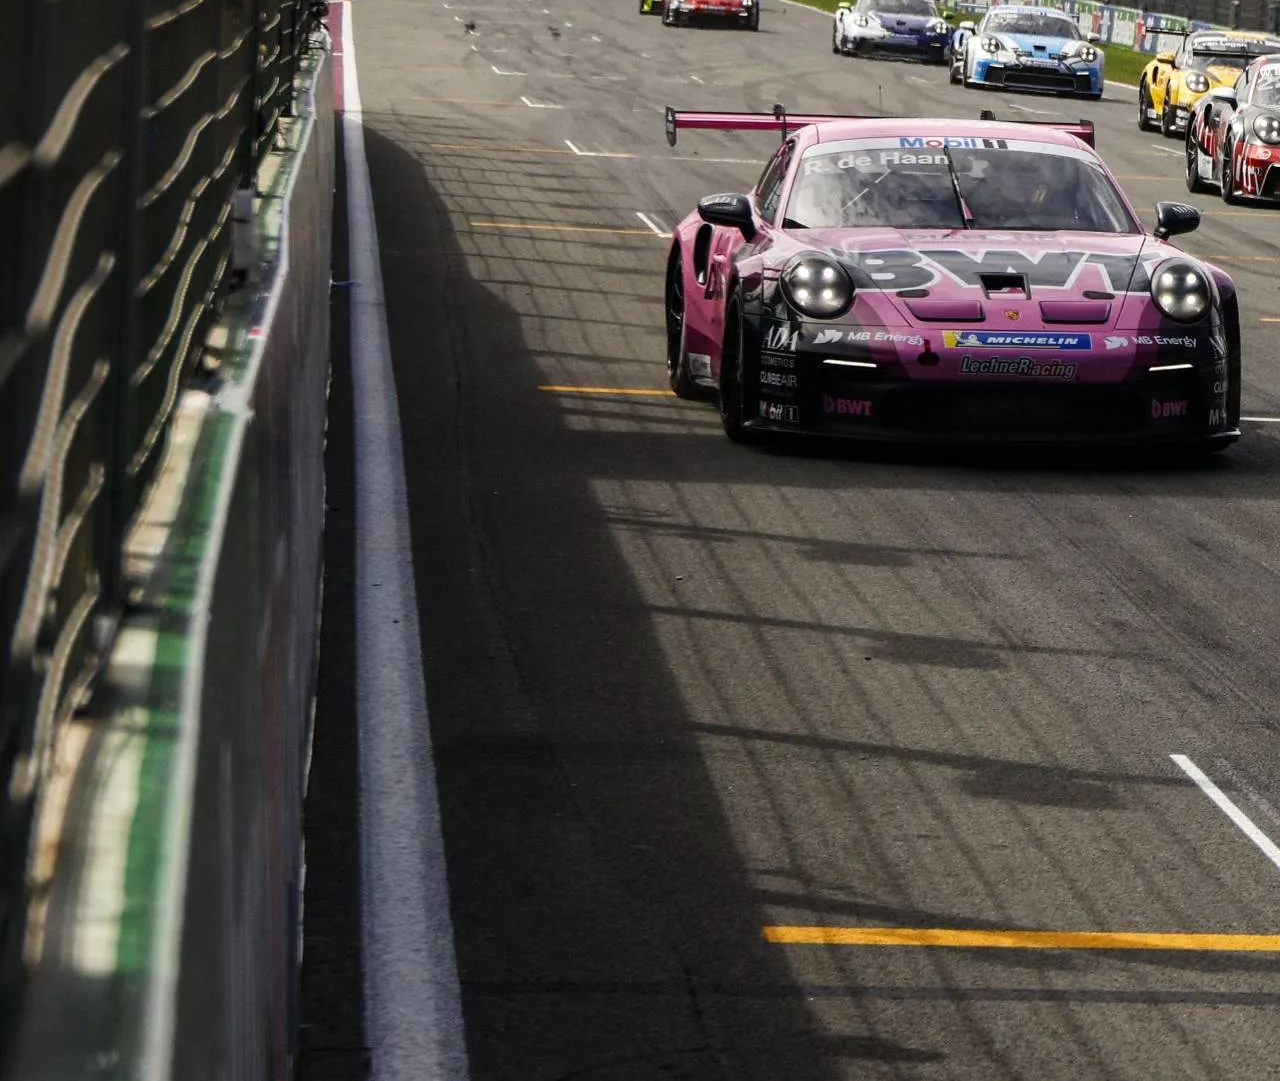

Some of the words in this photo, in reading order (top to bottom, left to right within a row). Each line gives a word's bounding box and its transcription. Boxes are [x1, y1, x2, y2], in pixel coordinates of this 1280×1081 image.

[900, 137, 976, 149] Mobil
[804, 161, 830, 176] R.
[838, 154, 872, 169] de
[880, 151, 949, 165] Haan
[838, 248, 1163, 294] BWT
[762, 325, 799, 352] ADA
[847, 331, 870, 341] MB
[875, 332, 925, 345] Energy
[986, 335, 1079, 345] MICHELIN
[1132, 335, 1153, 345] MB
[1154, 335, 1197, 348] Energy
[837, 398, 873, 416] BWT
[1163, 401, 1188, 416] BWT
